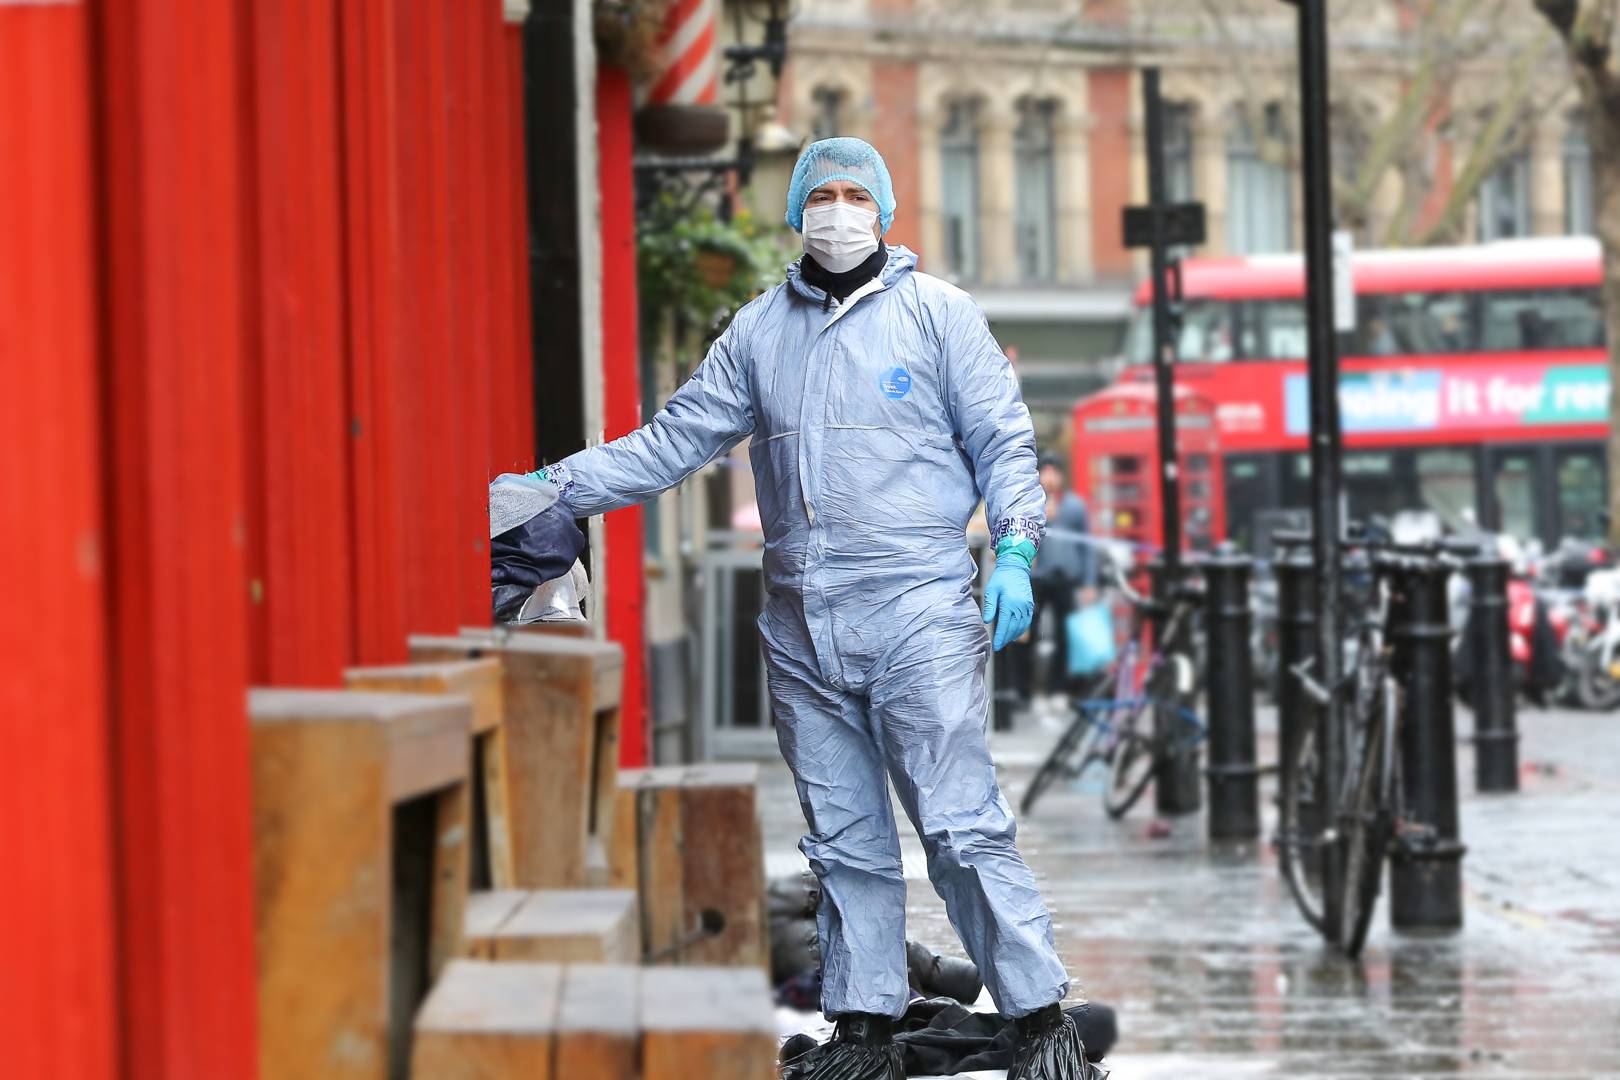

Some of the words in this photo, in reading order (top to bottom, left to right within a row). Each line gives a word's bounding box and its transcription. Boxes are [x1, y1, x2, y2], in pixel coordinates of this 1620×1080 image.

[1340, 374, 1440, 426] oing
[1447, 378, 1479, 415] it
[1486, 376, 1544, 415] for
